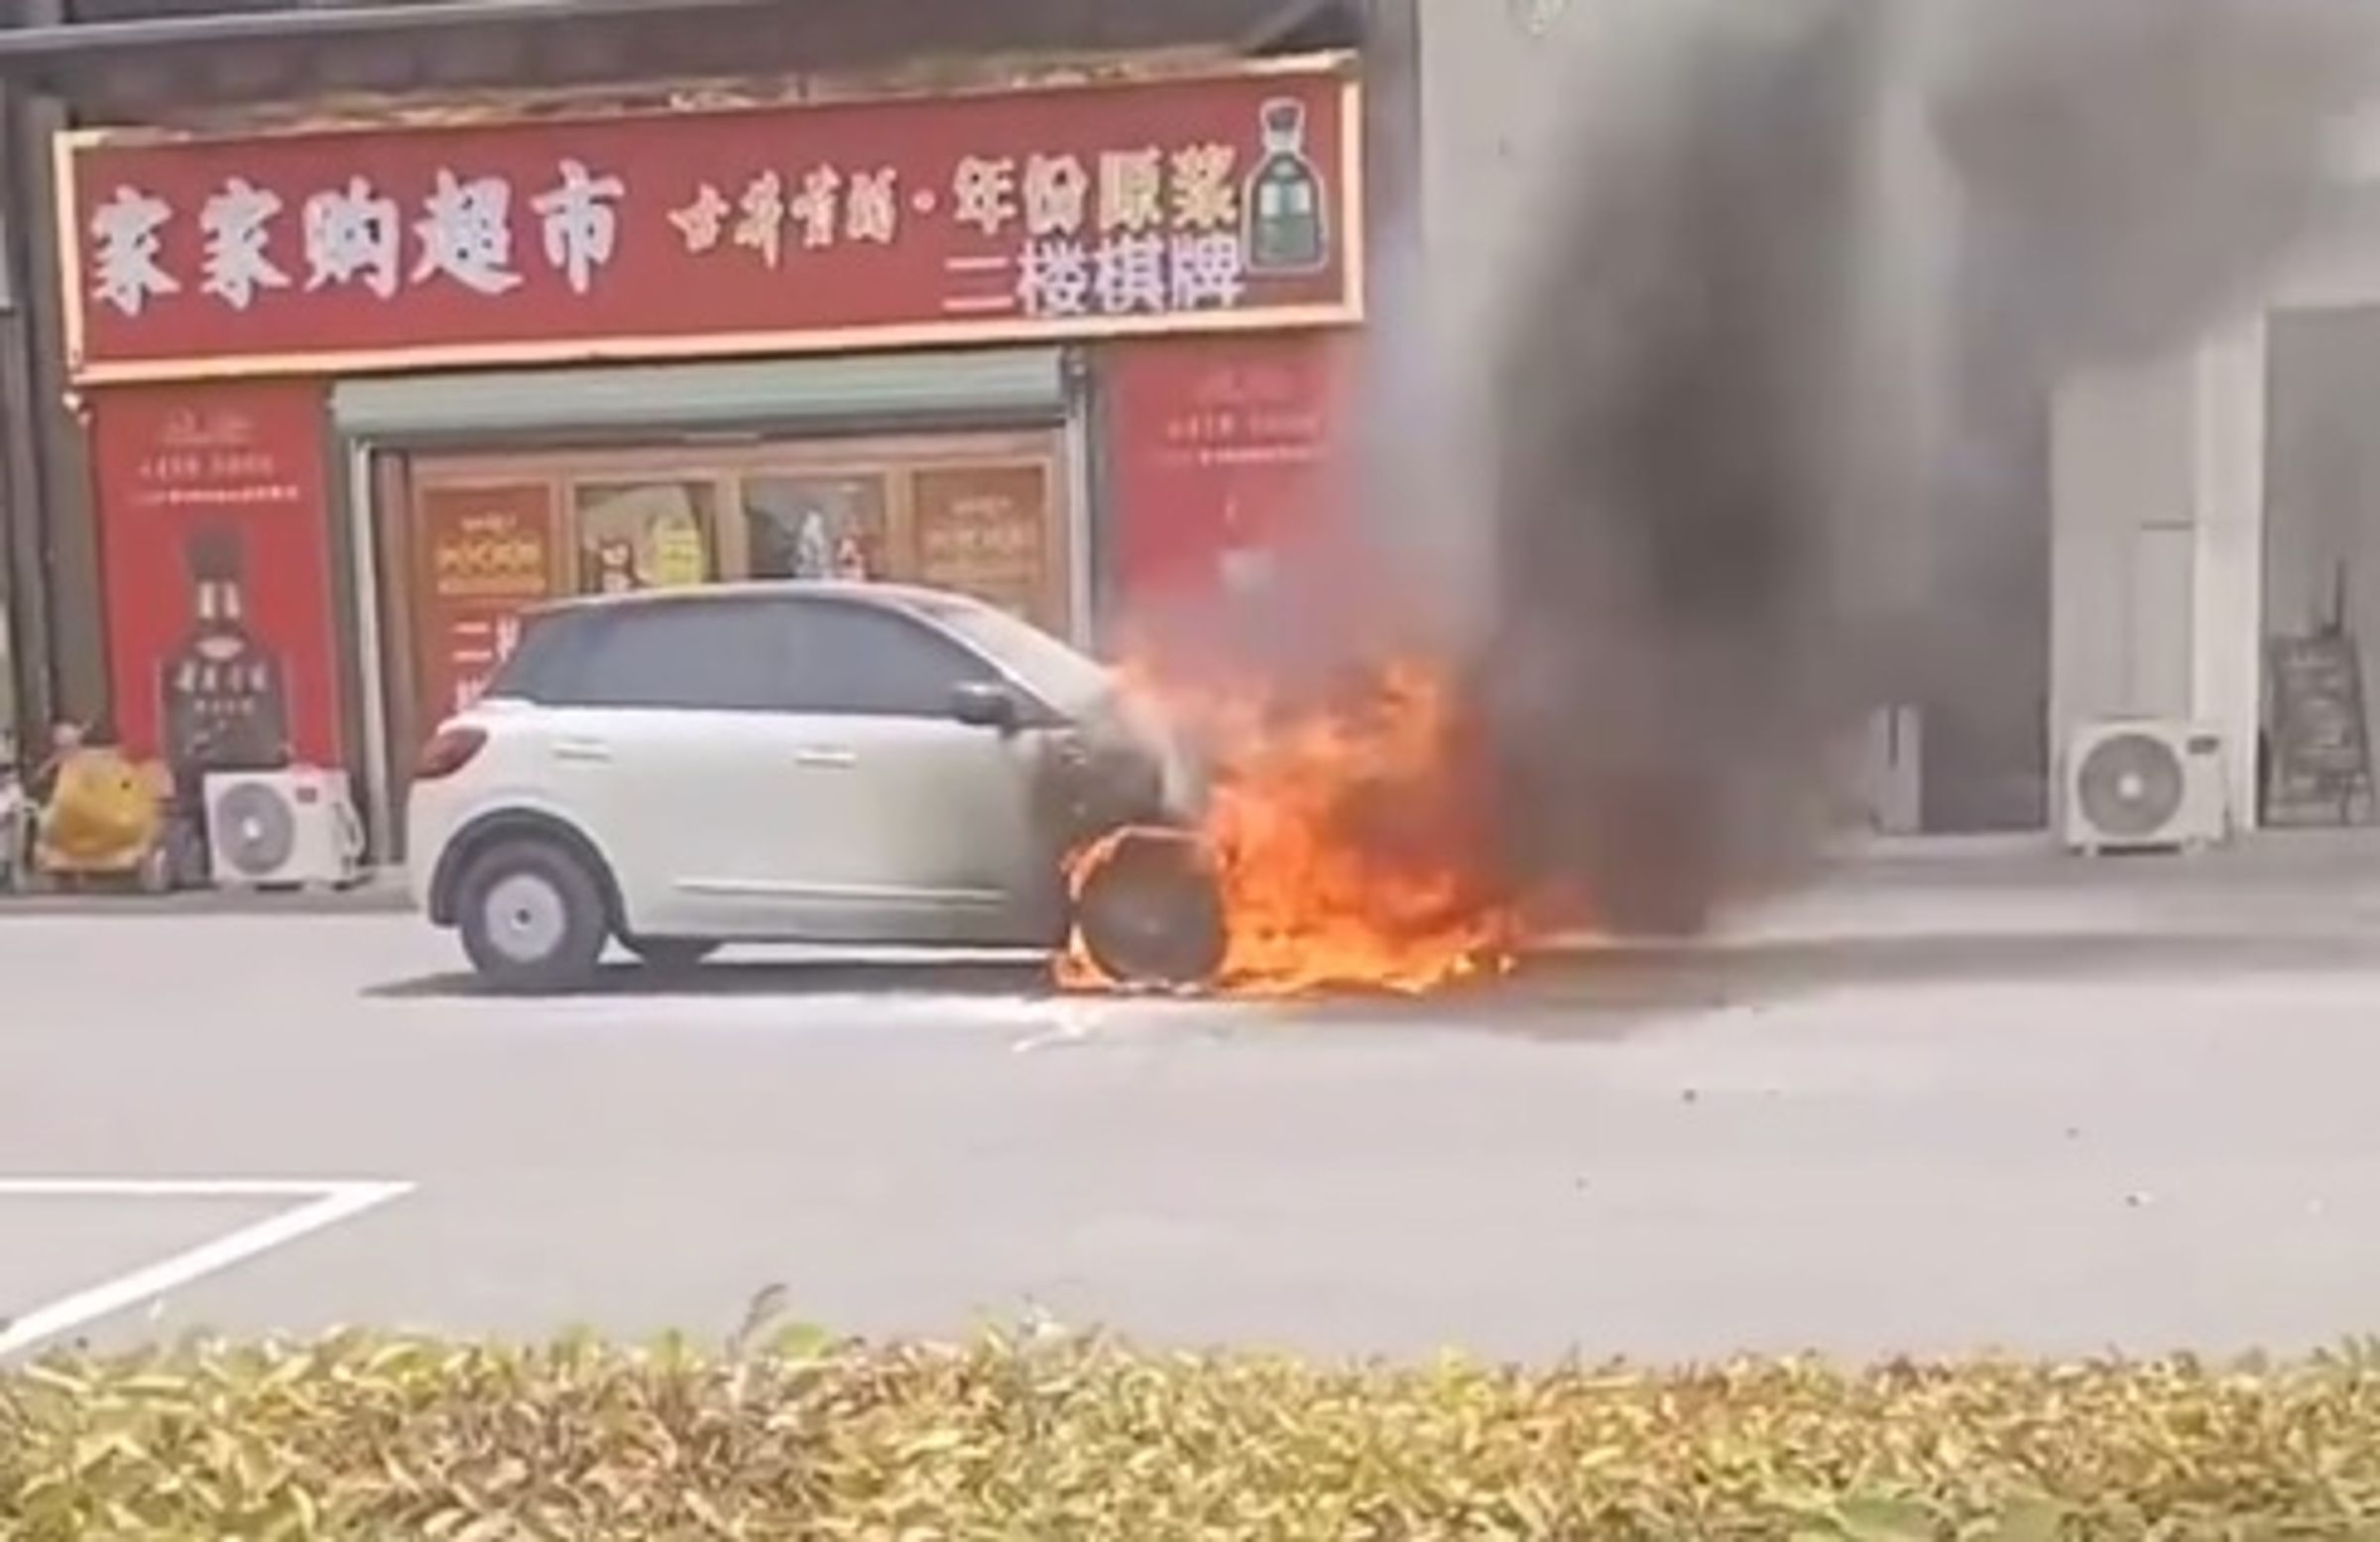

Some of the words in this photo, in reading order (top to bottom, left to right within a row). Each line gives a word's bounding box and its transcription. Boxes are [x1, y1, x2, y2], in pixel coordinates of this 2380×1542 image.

[91, 159, 625, 316] 家家购超市
[942, 232, 1248, 318] 二楼棋牌
